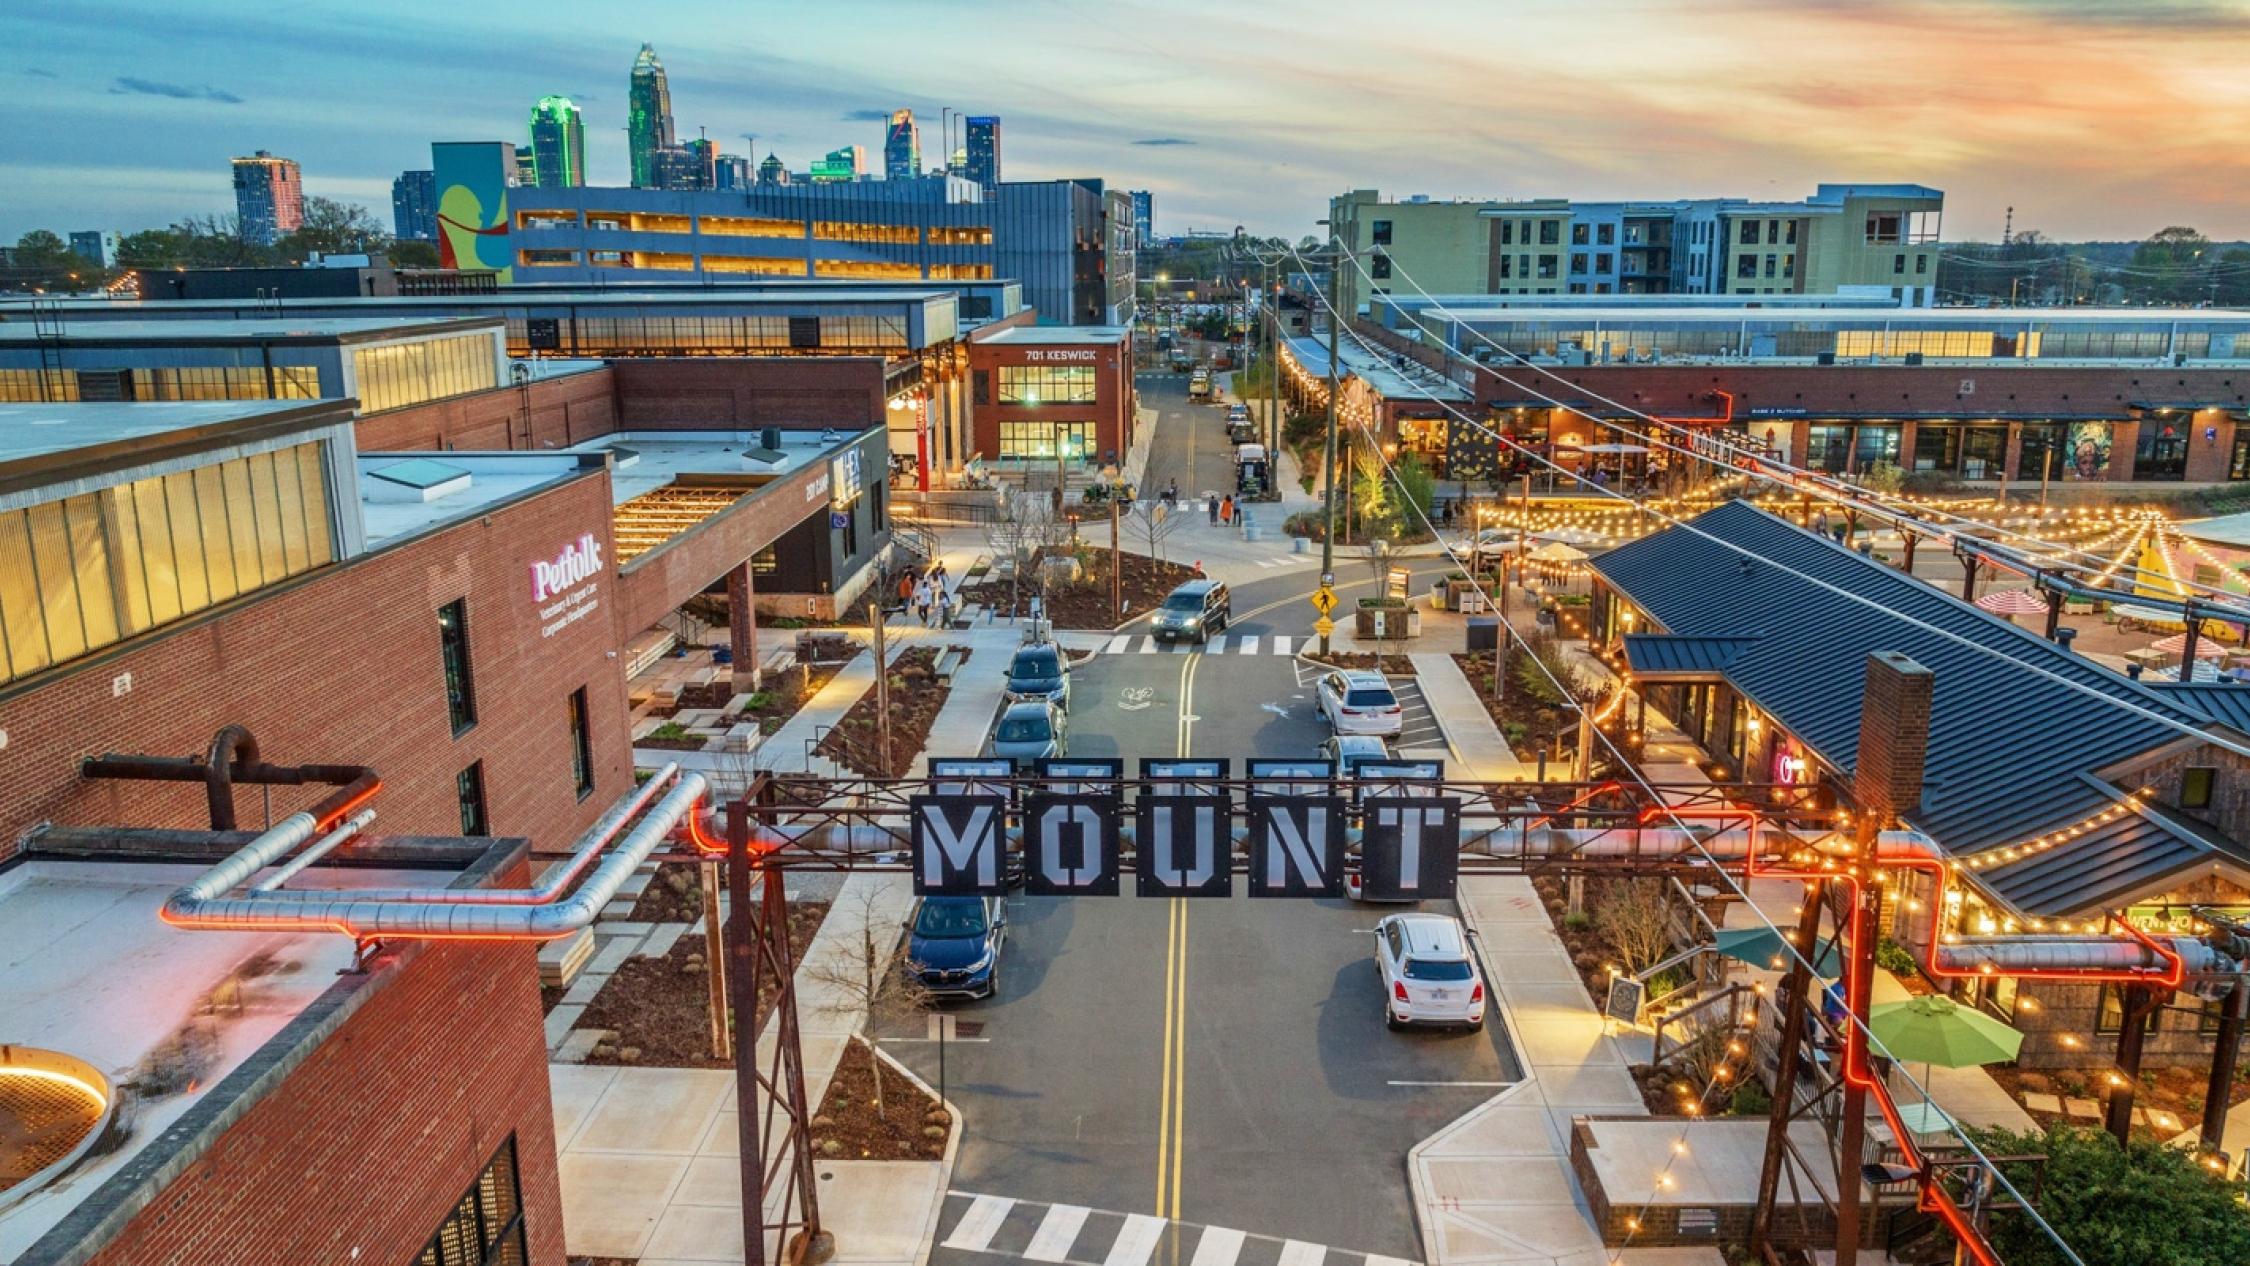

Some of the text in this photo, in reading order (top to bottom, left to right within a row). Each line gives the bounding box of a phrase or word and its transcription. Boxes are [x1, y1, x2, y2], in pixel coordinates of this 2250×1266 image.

[1025, 350, 1096, 360] 701 KESWICK
[532, 532, 603, 603] Petfolk
[921, 804, 1445, 889] MOUNT
